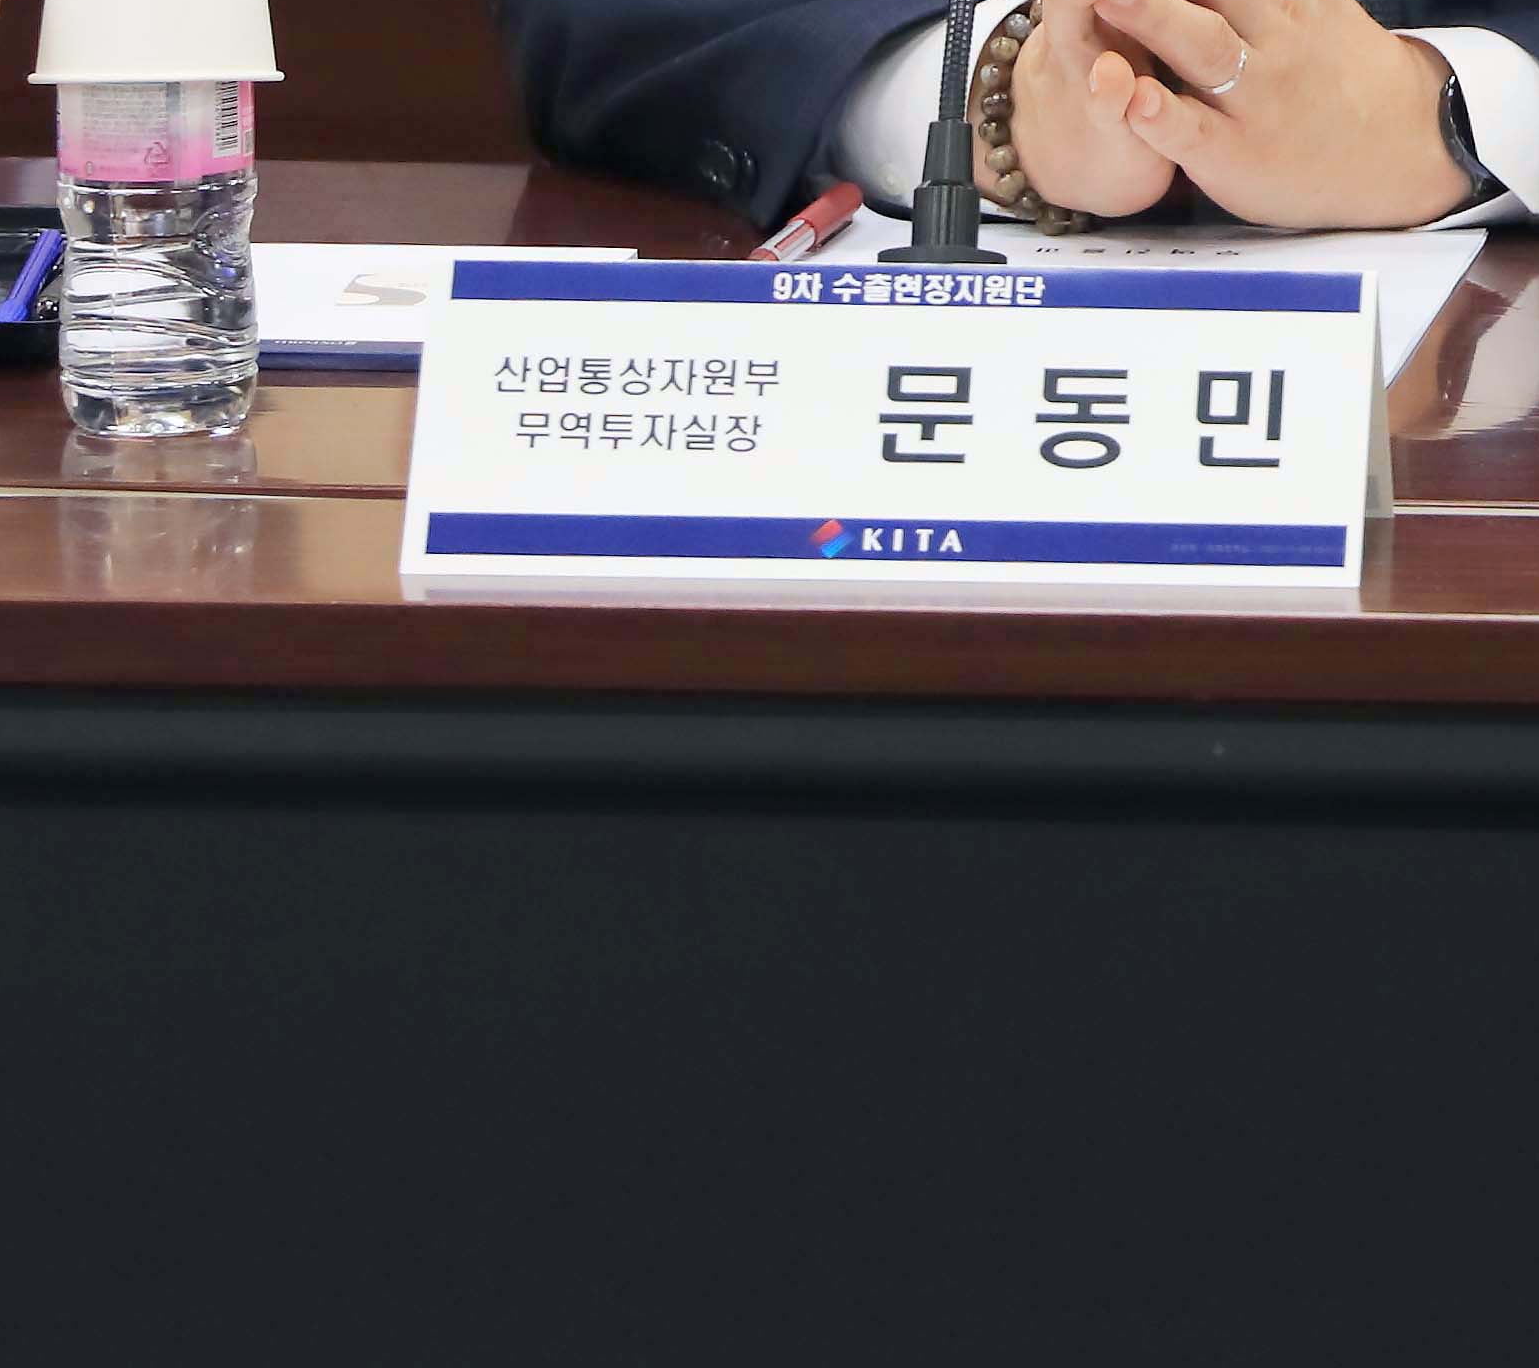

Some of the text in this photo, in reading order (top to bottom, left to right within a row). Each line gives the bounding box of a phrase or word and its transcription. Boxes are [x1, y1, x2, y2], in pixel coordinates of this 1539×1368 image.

[772, 271, 1046, 306] 9차 수출현장지원단
[494, 356, 781, 396] 산업통상자원부
[515, 412, 763, 453] 무역투자실장
[862, 527, 963, 553] KITA
